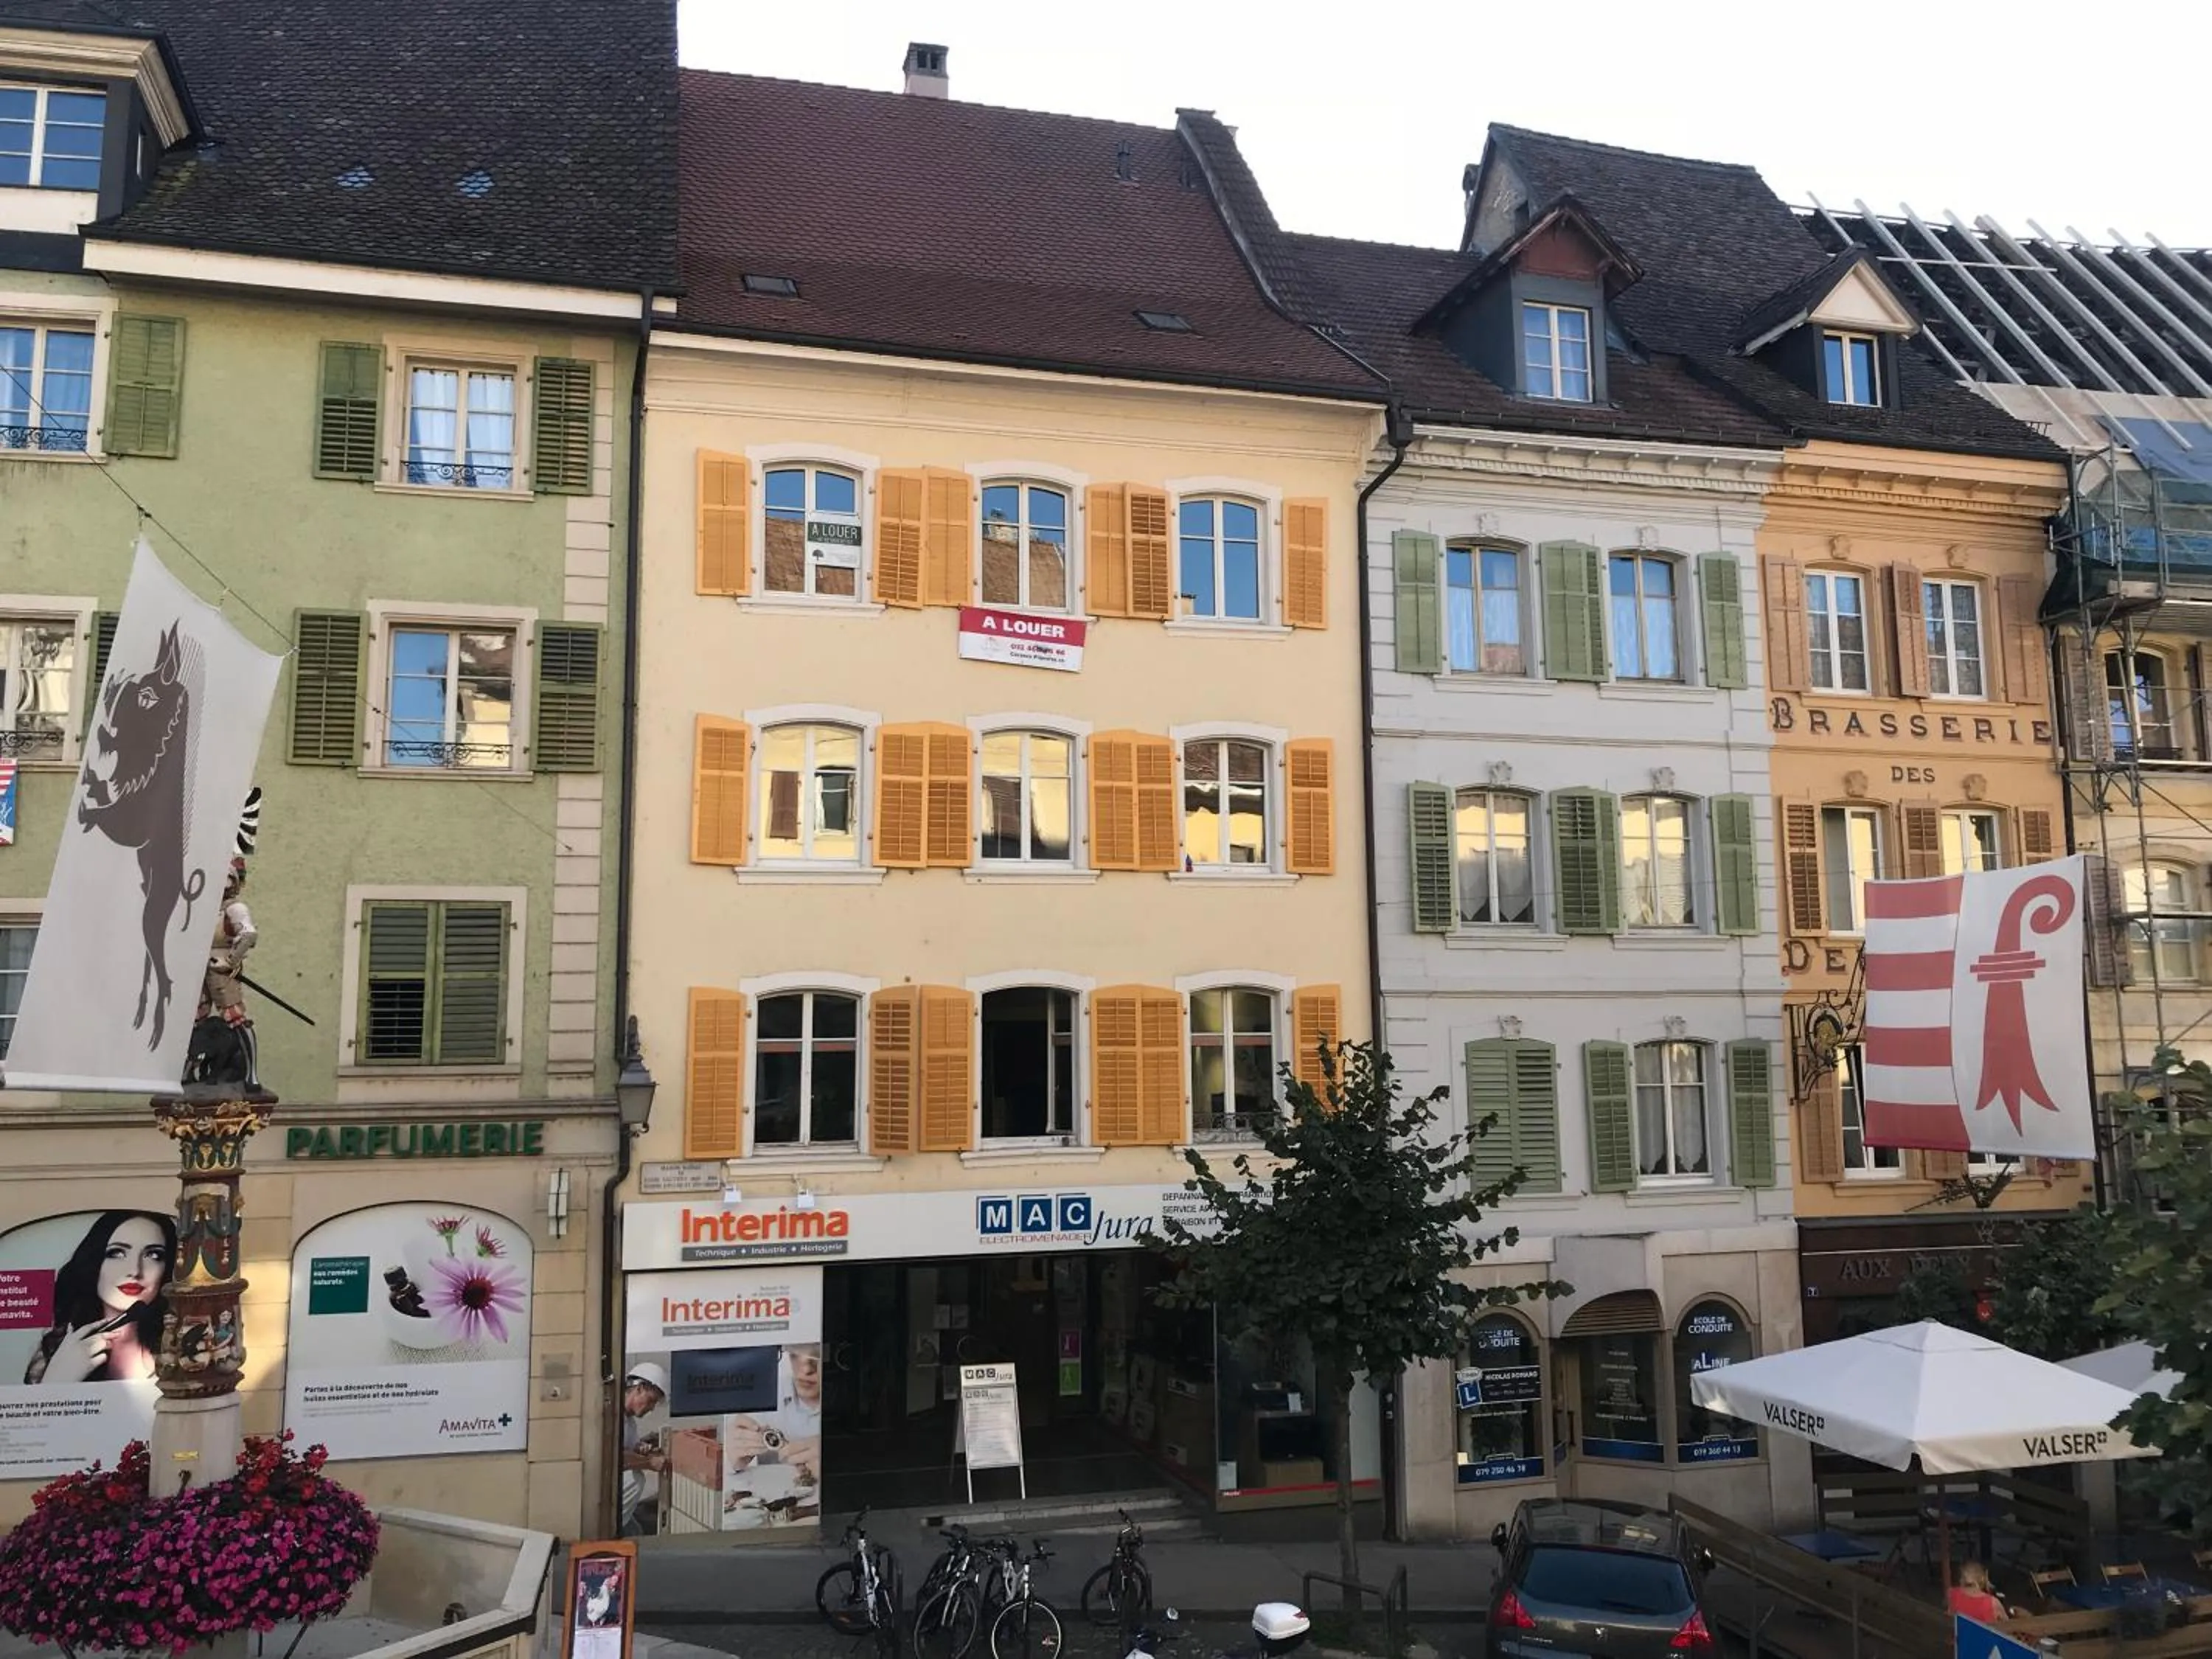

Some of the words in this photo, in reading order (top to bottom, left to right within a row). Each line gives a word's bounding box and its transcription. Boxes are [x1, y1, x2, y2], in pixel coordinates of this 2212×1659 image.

[812, 524, 819, 537] A
[822, 524, 858, 539] LOUER
[982, 616, 997, 630] A
[1003, 619, 1065, 638] LOUER
[1770, 697, 2053, 745] BRASSERIE
[1891, 765, 1936, 784] DES
[1781, 939, 1846, 973] DE
[287, 1122, 544, 1159] PARFUMERIE
[984, 1200, 1088, 1231] MAC
[1162, 1206, 1197, 1214] SERVICE
[682, 1206, 849, 1243] Interima
[979, 1232, 1092, 1245] ELECTROMENAGER
[695, 1249, 737, 1259] Technique
[751, 1247, 787, 1255] Industrie
[800, 1242, 844, 1254] Horlogerie
[1841, 1257, 1893, 1280] AUX
[0, 1287, 27, 1295] nstitut
[0, 1311, 34, 1319] mavita.
[662, 1293, 791, 1323] Interima
[1688, 1323, 1733, 1335] CONDUITE
[1464, 1387, 1477, 1402] L
[439, 1417, 496, 1434] AMAVITA
[1763, 1400, 1816, 1437] VALSER
[2023, 1433, 2097, 1458] VALSER
